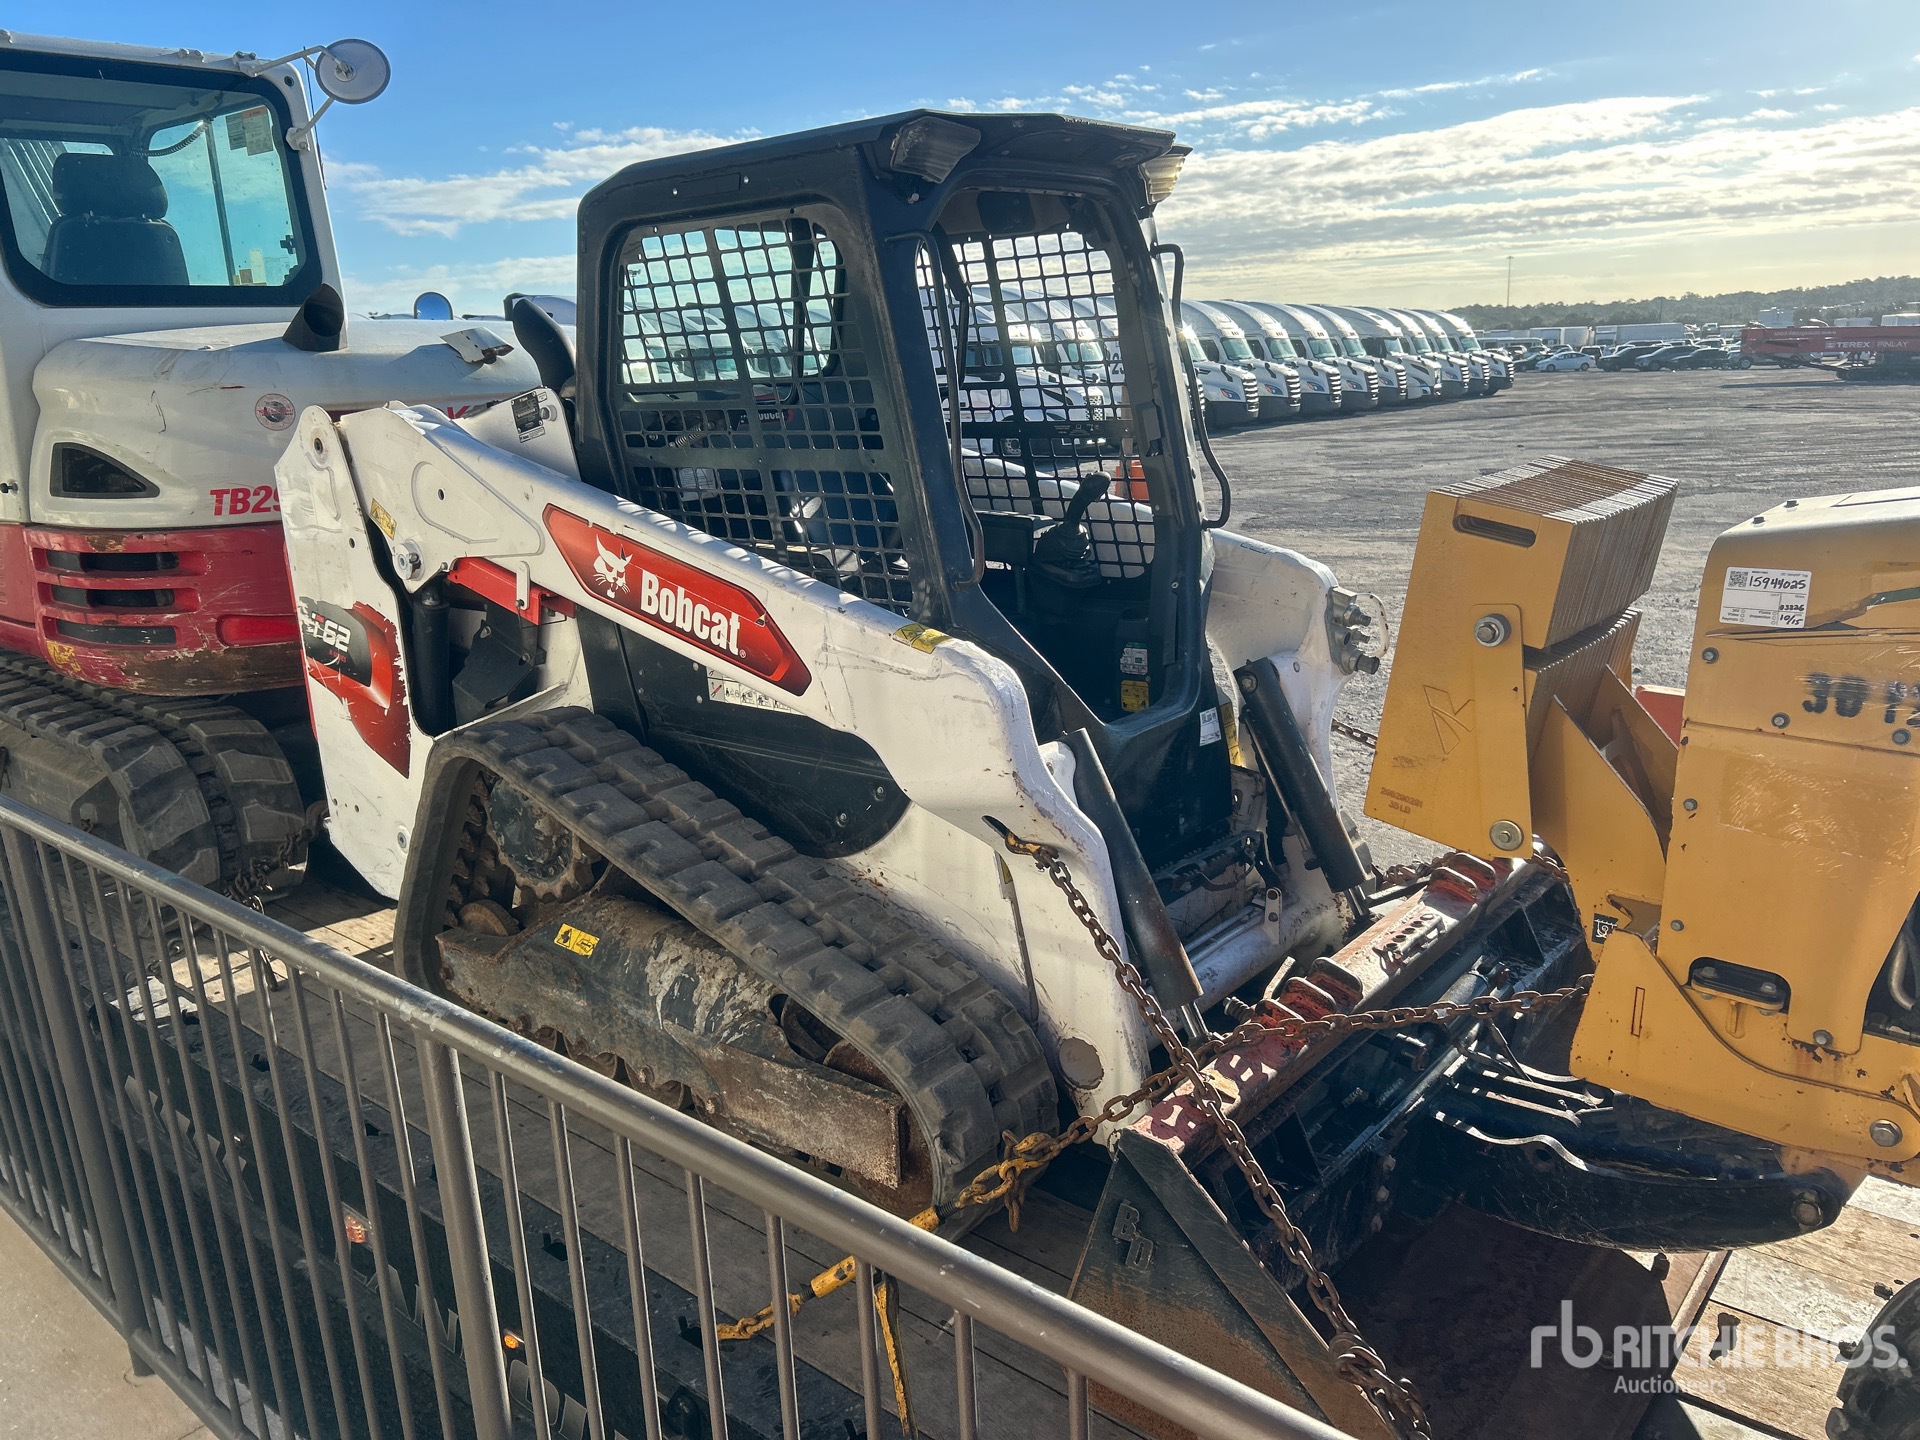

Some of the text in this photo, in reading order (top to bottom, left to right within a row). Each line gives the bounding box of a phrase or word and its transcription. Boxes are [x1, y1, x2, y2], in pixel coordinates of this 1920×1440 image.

[1749, 575, 1806, 590] 15944025
[641, 569, 740, 656] Bobcat
[1780, 614, 1804, 626] 10/15
